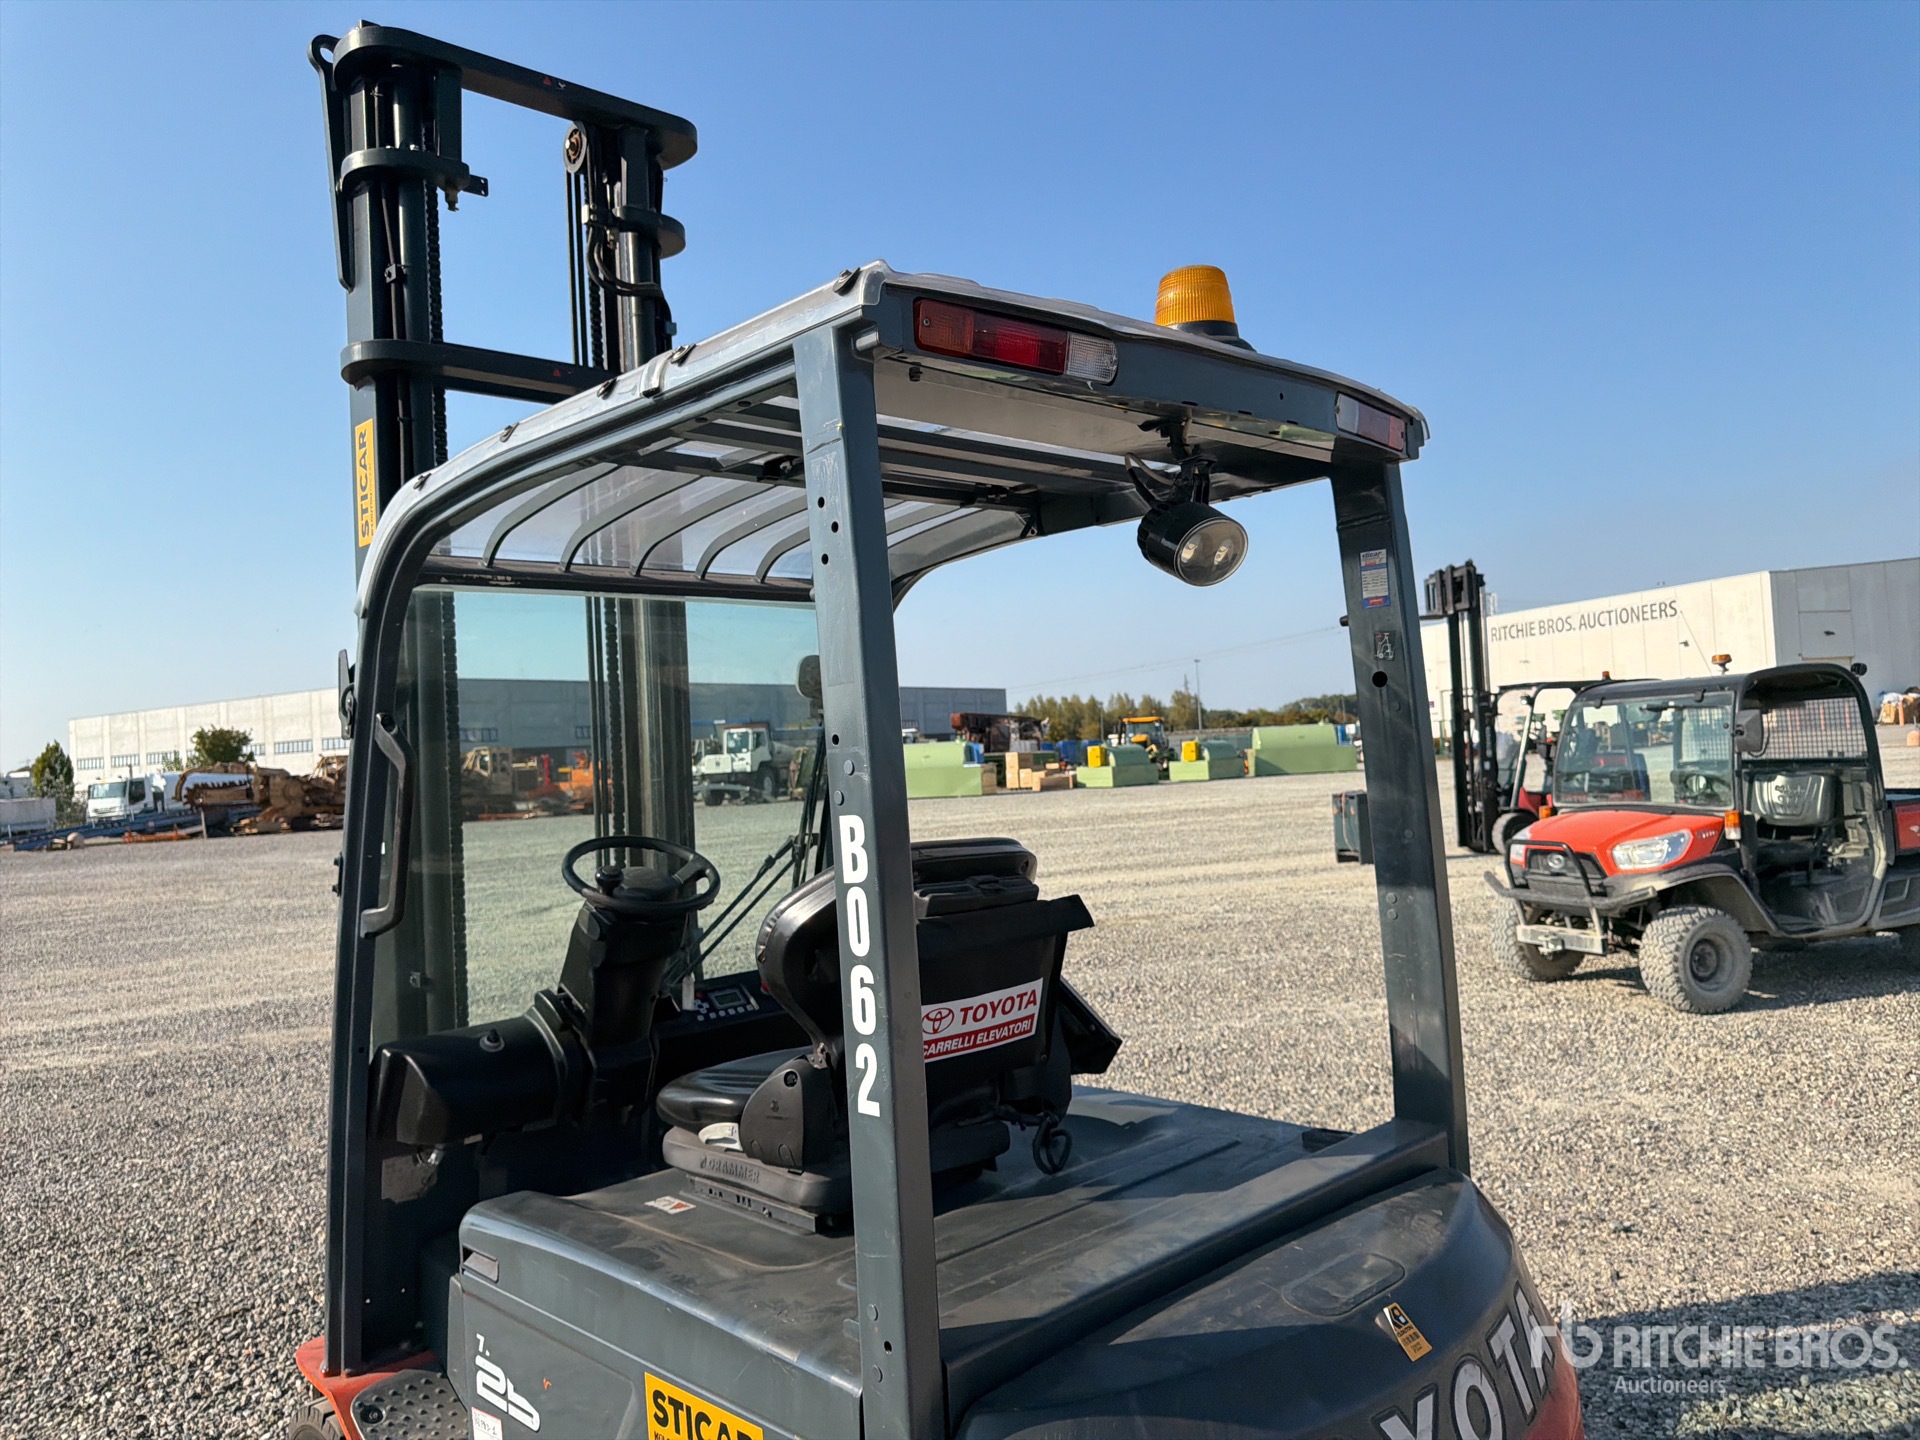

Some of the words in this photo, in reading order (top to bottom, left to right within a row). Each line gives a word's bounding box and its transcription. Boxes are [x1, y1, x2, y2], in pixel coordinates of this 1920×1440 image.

[358, 428, 370, 538] STICAR
[1490, 621, 1536, 642] RITCHIE
[1538, 616, 1576, 636] BROS.
[1578, 600, 1678, 631] AUCTIONEERS
[838, 814, 881, 1117] B062
[960, 989, 1038, 1025] TOYOTA
[922, 1034, 975, 1057] CARRELLI
[976, 1018, 1033, 1045] ELEVATORI
